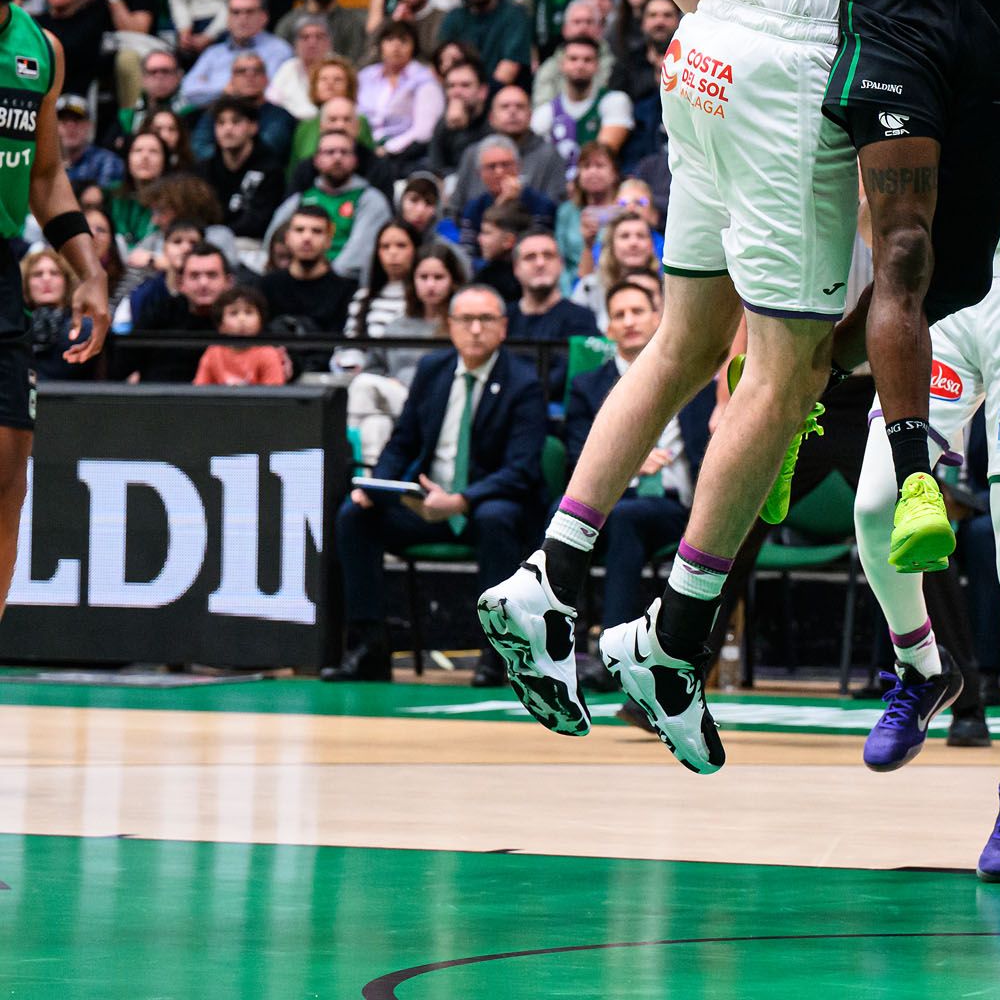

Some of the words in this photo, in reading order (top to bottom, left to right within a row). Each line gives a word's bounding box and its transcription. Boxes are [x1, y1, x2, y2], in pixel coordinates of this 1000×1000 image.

[687, 48, 733, 84] COSTA
[681, 68, 695, 89] DEL
[698, 78, 729, 102] SOL
[861, 79, 903, 94] SPALDING
